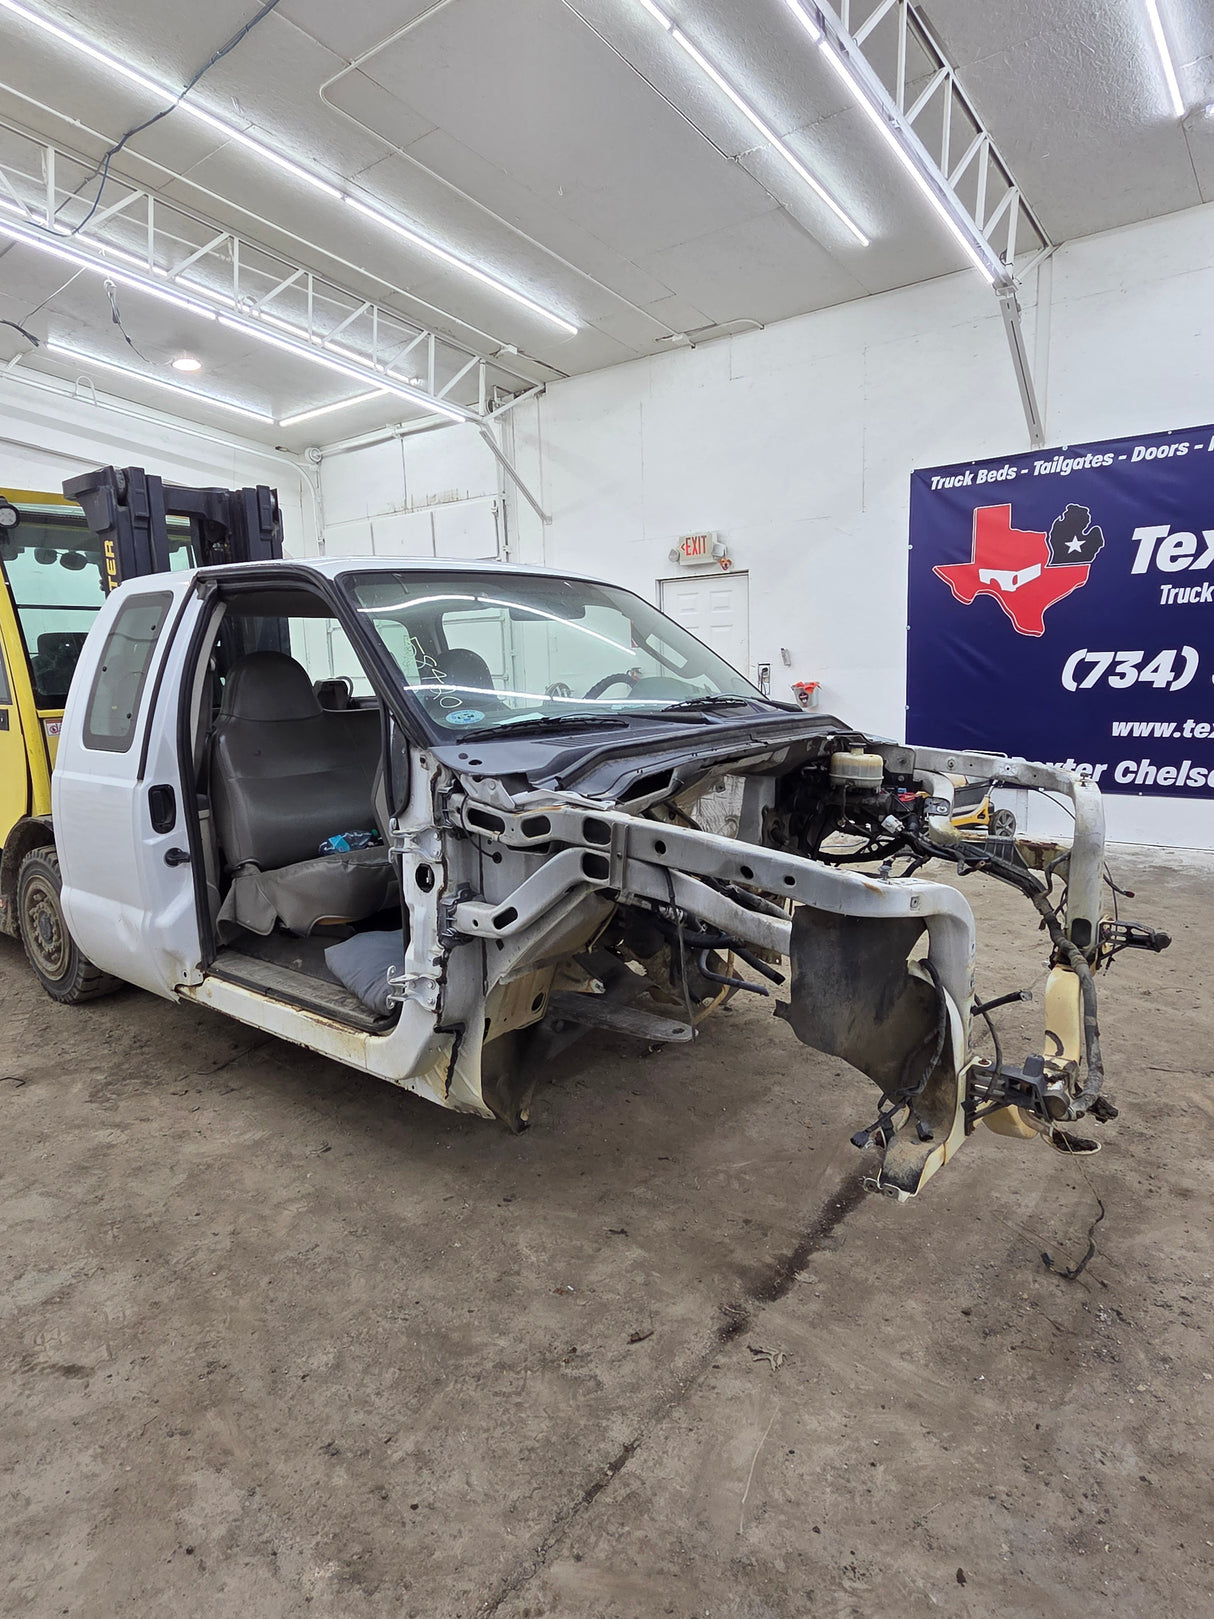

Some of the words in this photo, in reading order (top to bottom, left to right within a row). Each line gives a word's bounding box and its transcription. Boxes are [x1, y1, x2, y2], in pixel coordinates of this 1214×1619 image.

[930, 470, 974, 491] Truck
[976, 464, 1017, 485] Beds
[1033, 452, 1114, 476] Tailgates
[1130, 440, 1189, 463] Doors
[685, 535, 707, 556] EXIT
[1160, 582, 1214, 605] Truck
[1061, 645, 1200, 692] (734)
